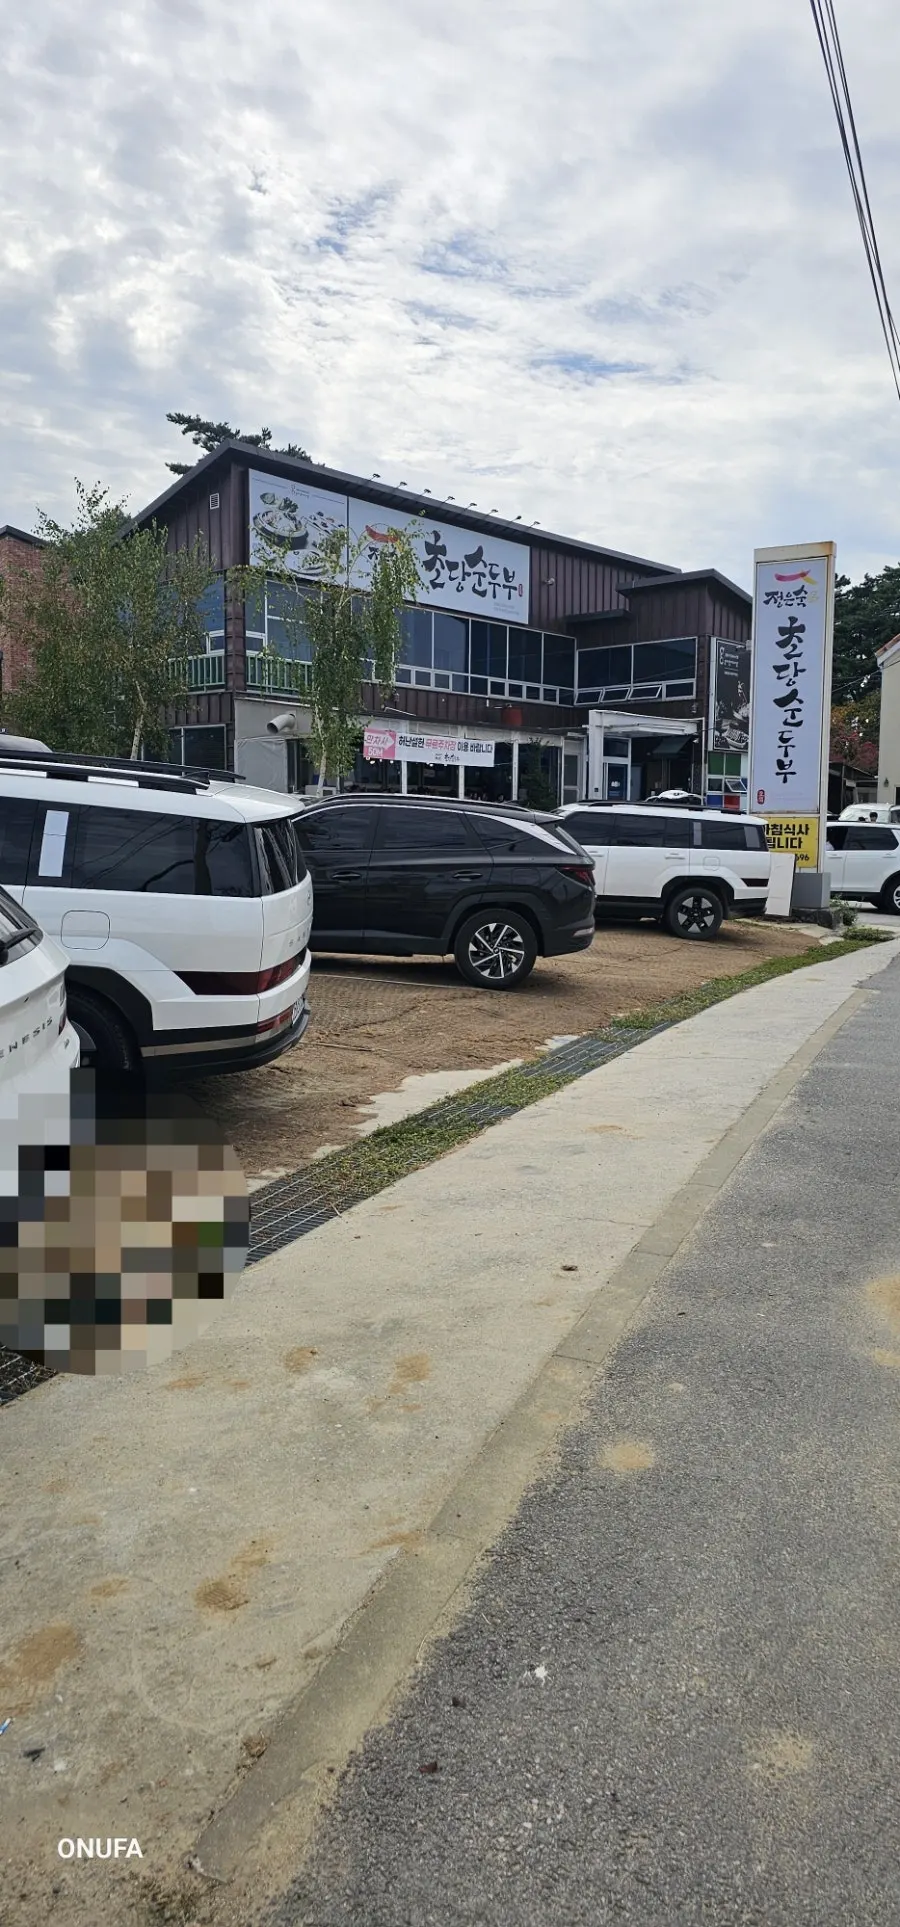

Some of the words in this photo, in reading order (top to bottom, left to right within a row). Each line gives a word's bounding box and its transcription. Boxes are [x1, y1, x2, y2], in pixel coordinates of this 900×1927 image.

[422, 530, 518, 600] 초당순두부
[763, 585, 808, 608] 정은숙
[773, 616, 806, 785] 초당순두부
[398, 735, 425, 749] 허난설헌
[425, 738, 456, 752] 무료주차장
[457, 741, 469, 752] 이용
[470, 742, 493, 753] 바랍니다
